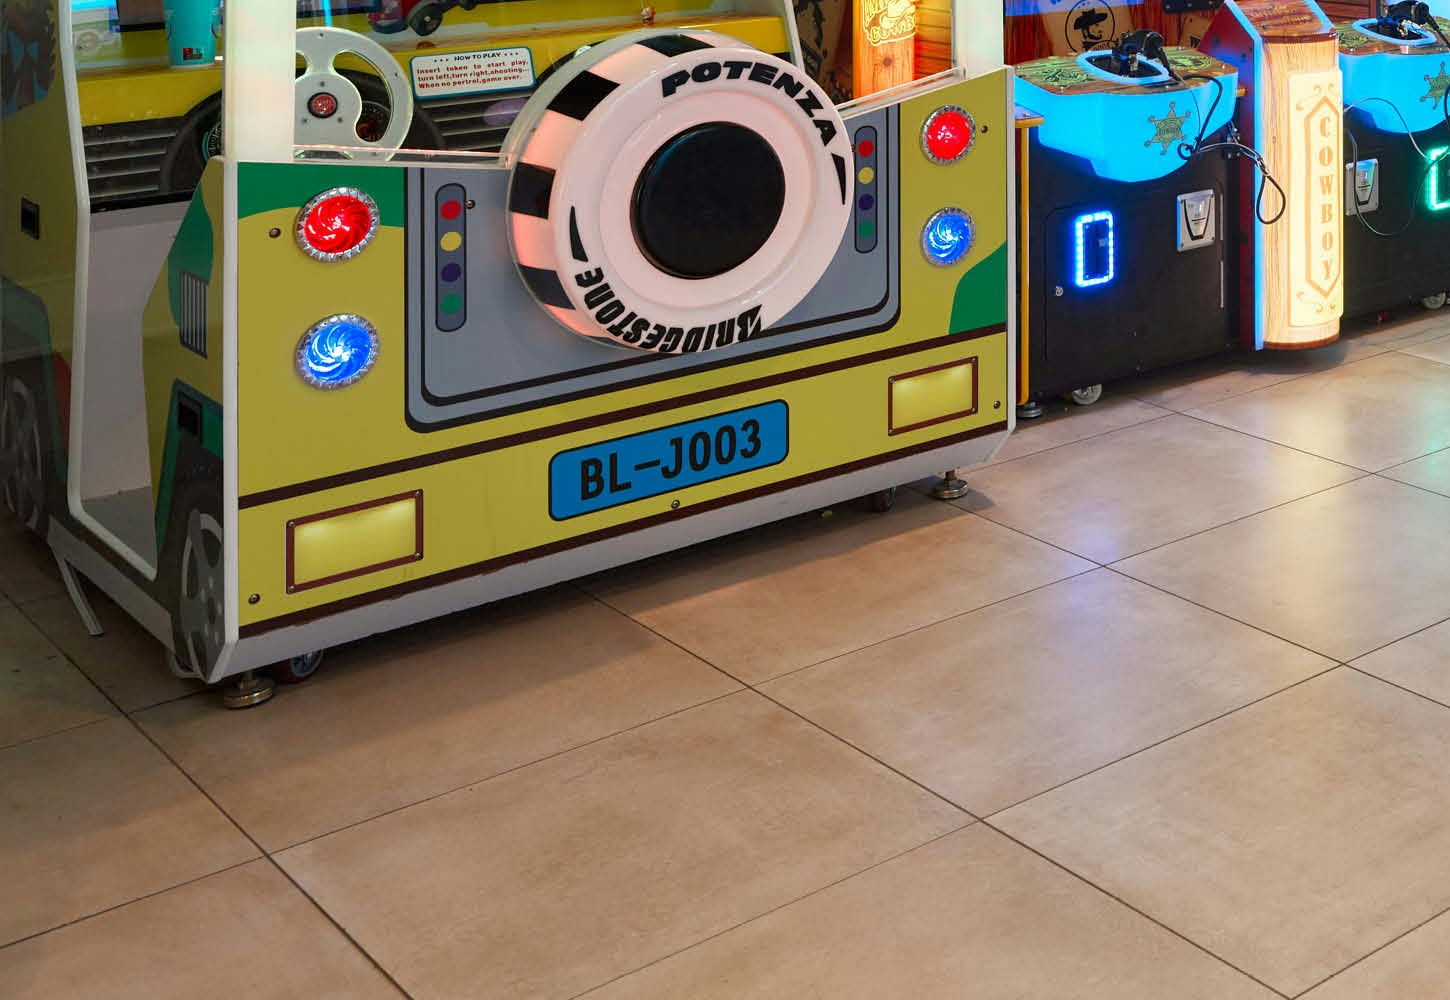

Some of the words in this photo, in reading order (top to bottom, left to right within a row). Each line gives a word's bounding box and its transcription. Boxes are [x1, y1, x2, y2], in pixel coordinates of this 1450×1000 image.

[417, 67, 441, 75] Insert
[418, 74, 435, 82] turn
[454, 54, 471, 62] HOW
[661, 60, 838, 148] POTENZA
[1318, 115, 1335, 281] COWBOY
[574, 267, 764, 354] BRIDGESTONE
[580, 418, 762, 501] BL-J003
